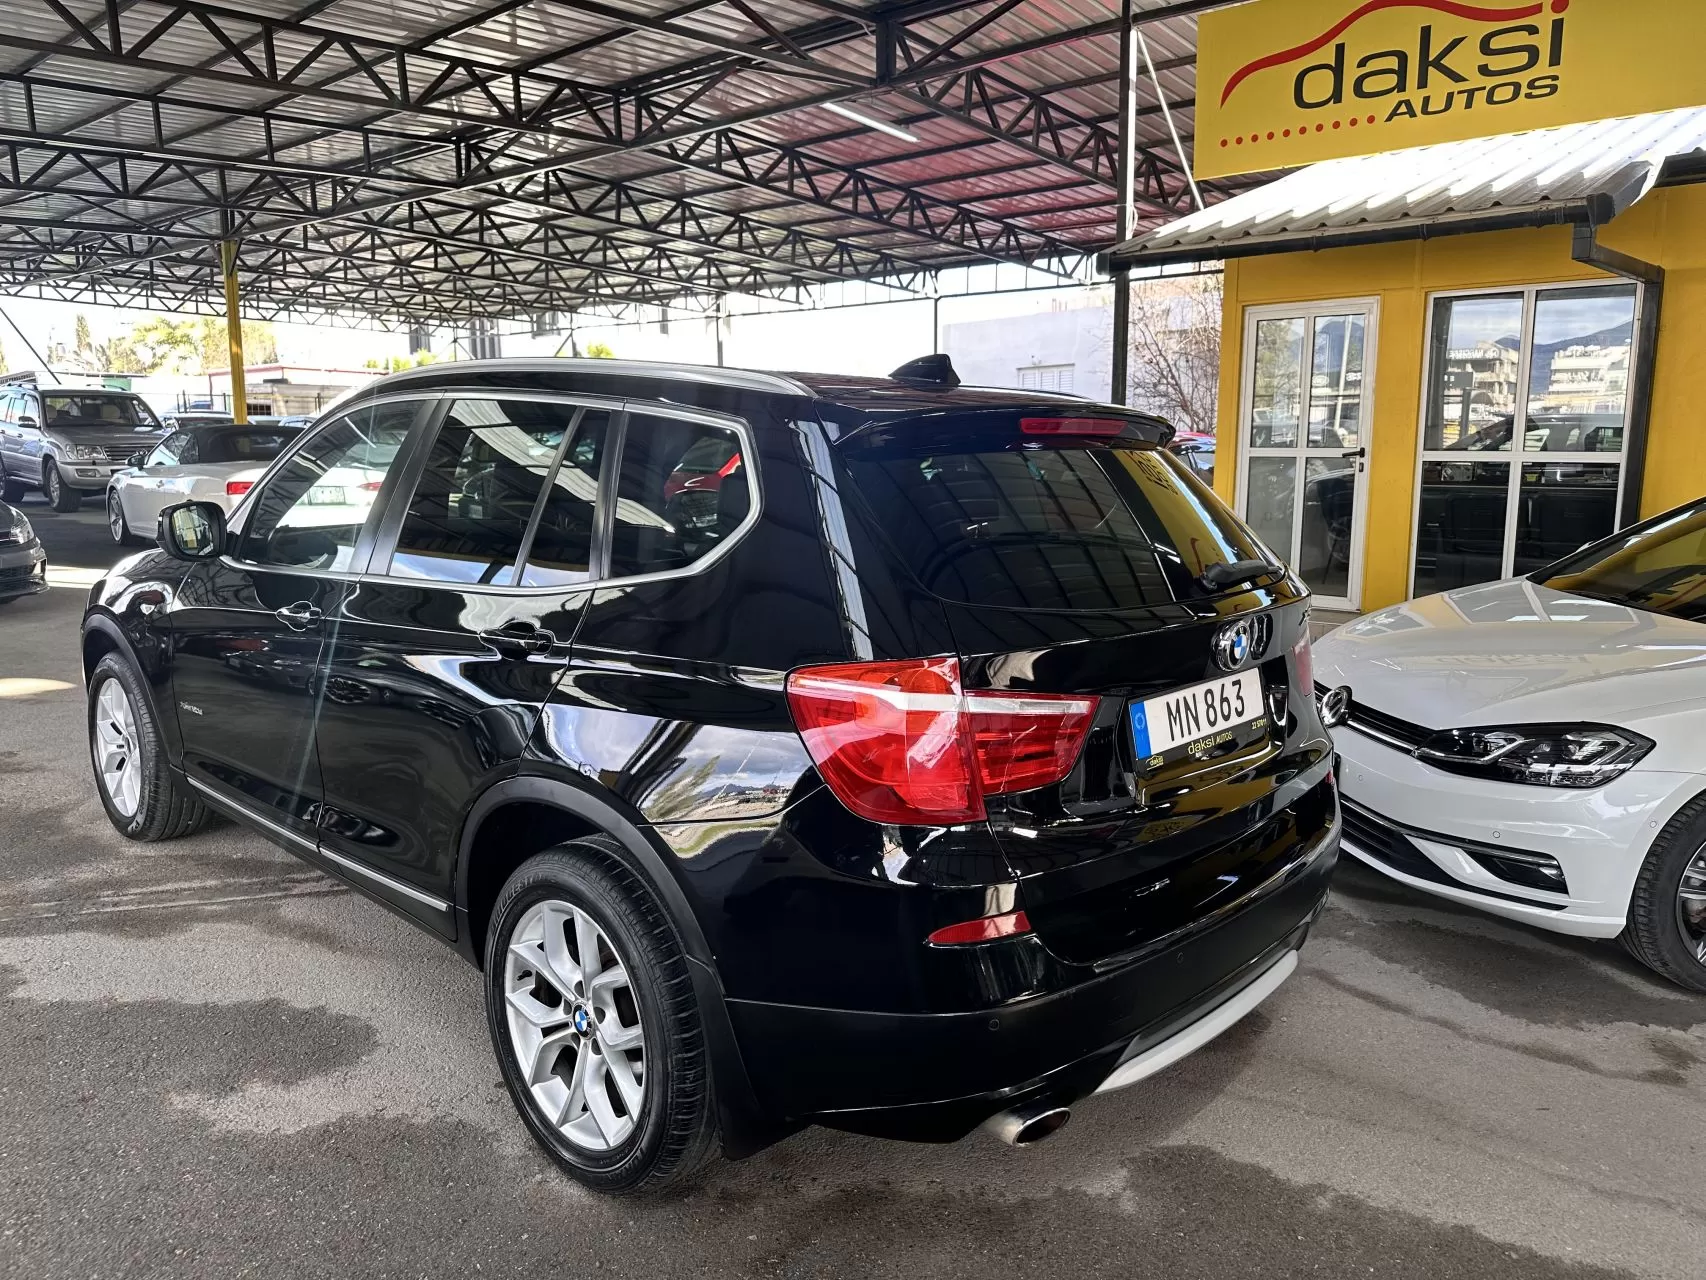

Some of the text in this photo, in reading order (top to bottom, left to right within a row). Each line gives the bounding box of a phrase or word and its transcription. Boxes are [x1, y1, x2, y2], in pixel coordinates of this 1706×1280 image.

[1293, 0, 1569, 110] daksi
[1384, 74, 1560, 123] AUTOS
[1166, 679, 1245, 741] MN 863
[1187, 735, 1215, 755] daksi
